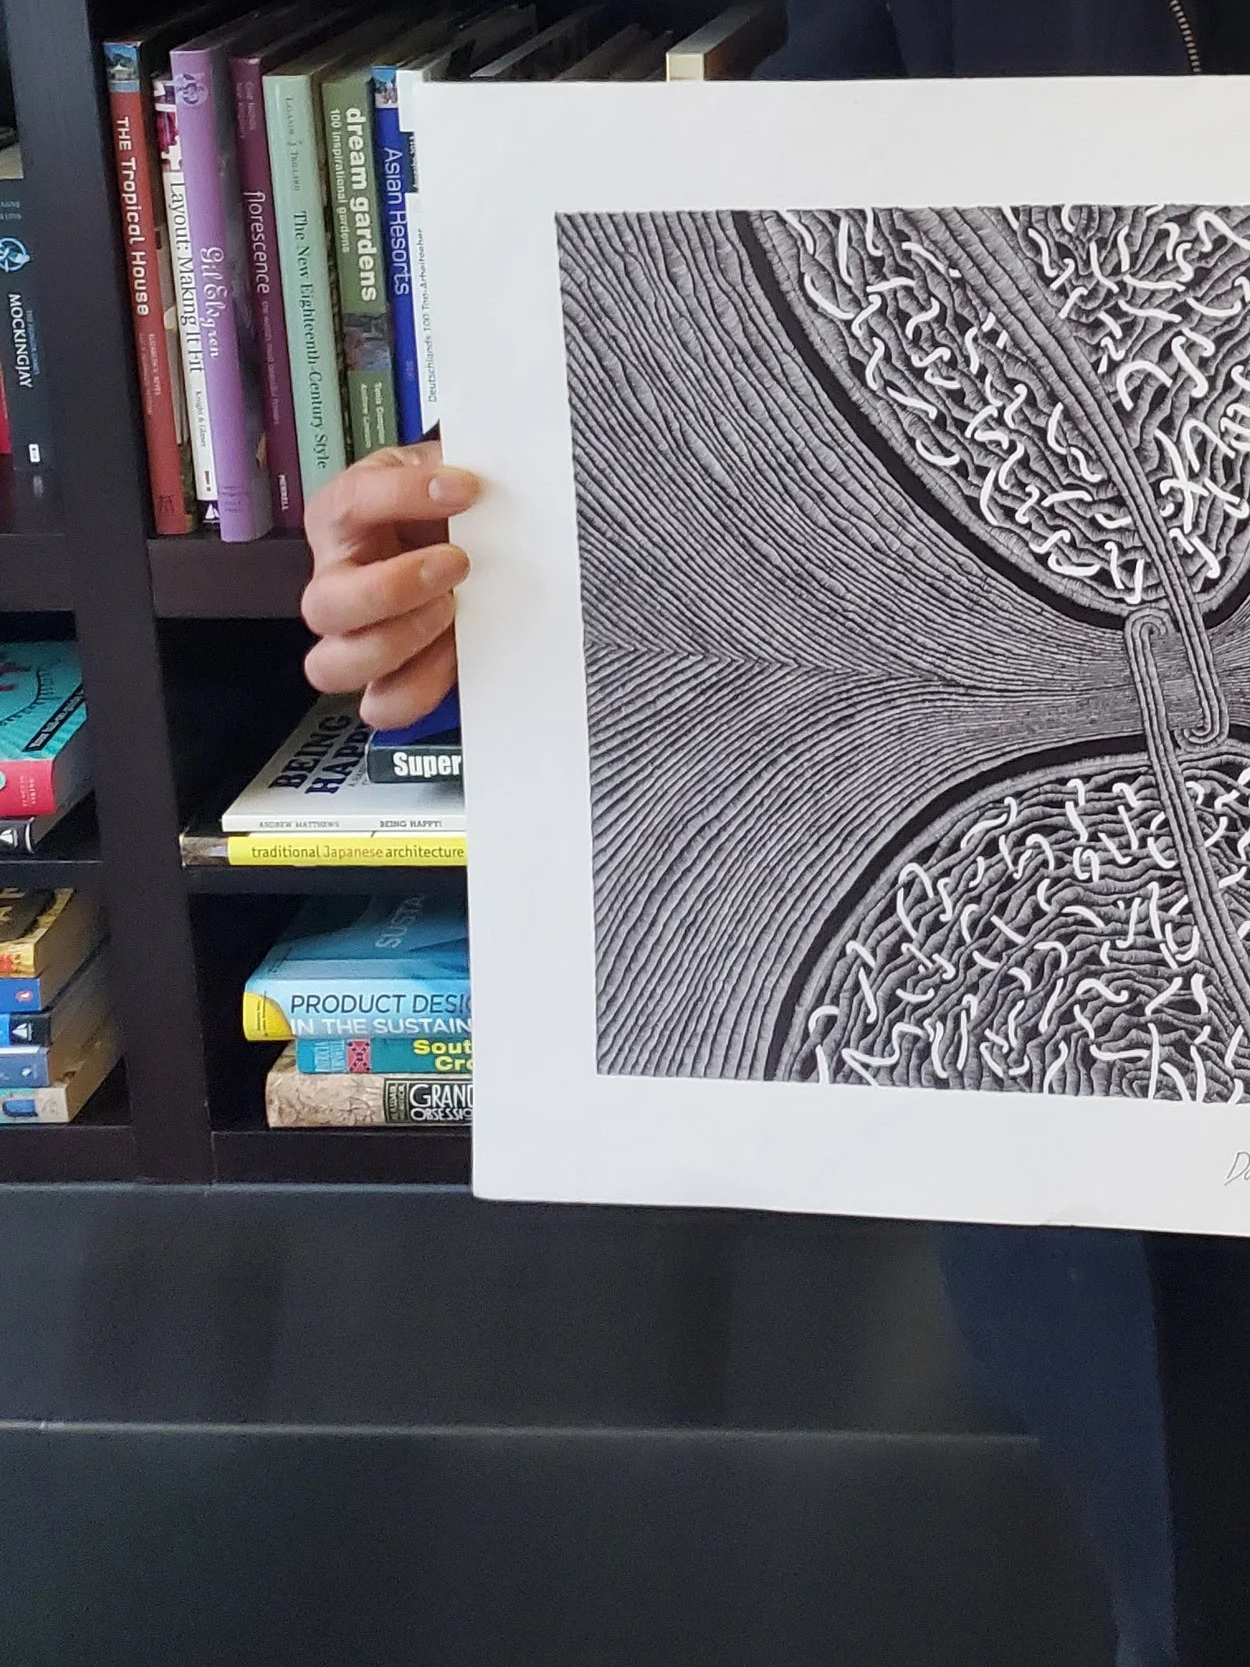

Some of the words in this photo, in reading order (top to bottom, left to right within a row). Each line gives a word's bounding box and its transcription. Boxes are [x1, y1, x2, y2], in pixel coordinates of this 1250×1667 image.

[115, 117, 131, 150] THE
[345, 107, 368, 191] dream
[121, 156, 146, 247] Tropical
[293, 211, 308, 241] The
[297, 243, 311, 279] New
[350, 198, 378, 303] gardens
[131, 252, 150, 316] House
[299, 284, 324, 431] Eighteenth-Century
[313, 435, 330, 470] Style
[393, 752, 462, 778] Super
[252, 845, 320, 858] traditional
[323, 846, 383, 860] Japanese
[386, 845, 464, 858] architecture
[291, 994, 407, 1014] PRODUCT
